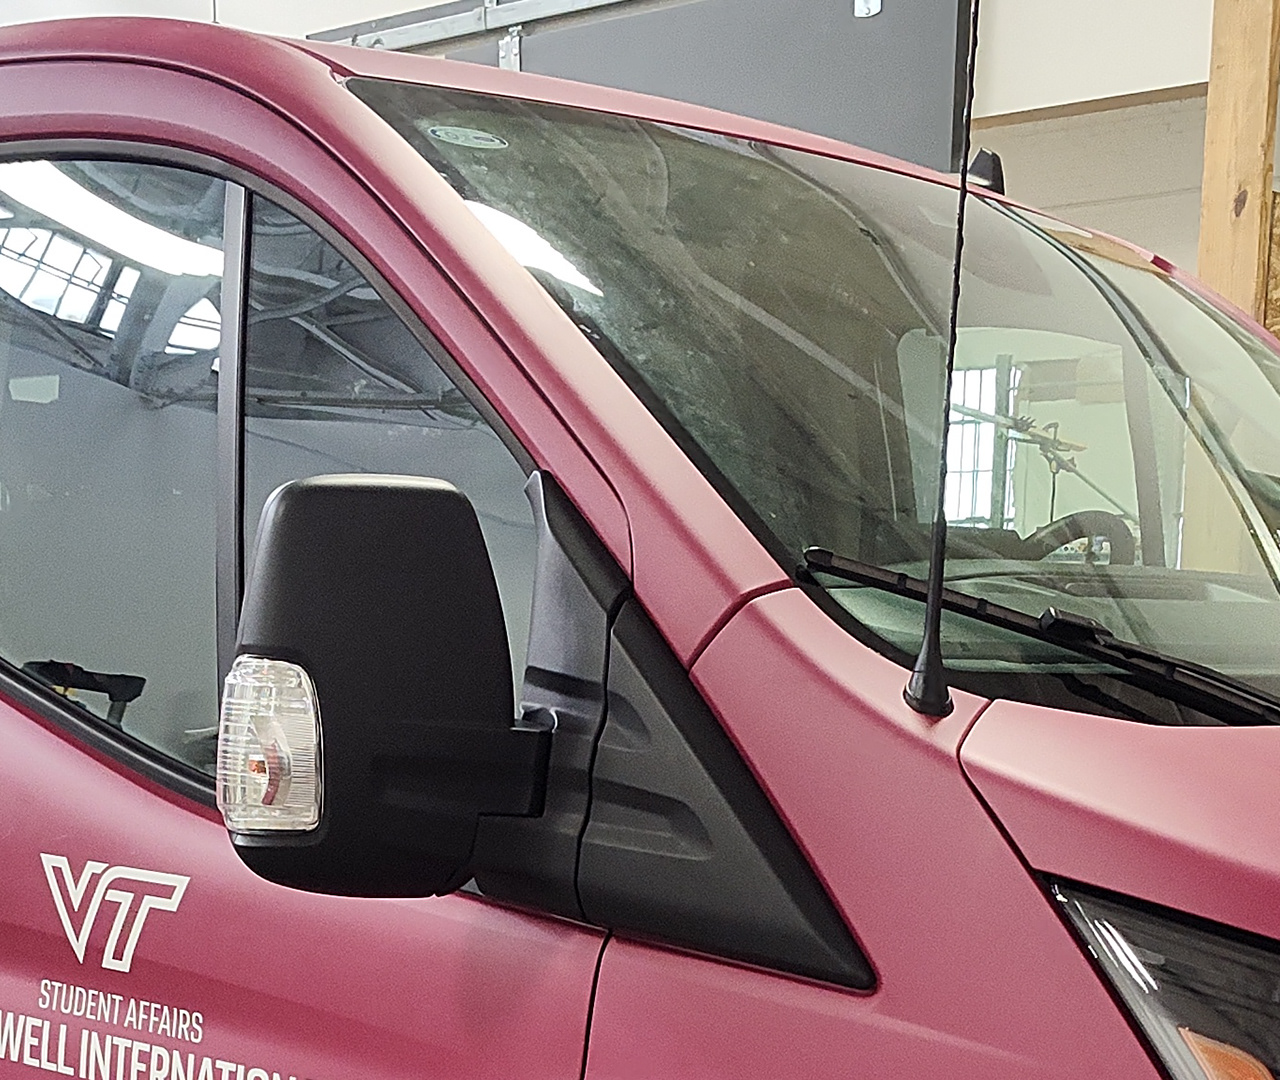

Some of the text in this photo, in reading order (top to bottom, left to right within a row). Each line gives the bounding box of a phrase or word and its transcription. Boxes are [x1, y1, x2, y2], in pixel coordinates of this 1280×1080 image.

[39, 852, 192, 973] VT
[37, 979, 204, 1044] STUDENT AFFAIRS
